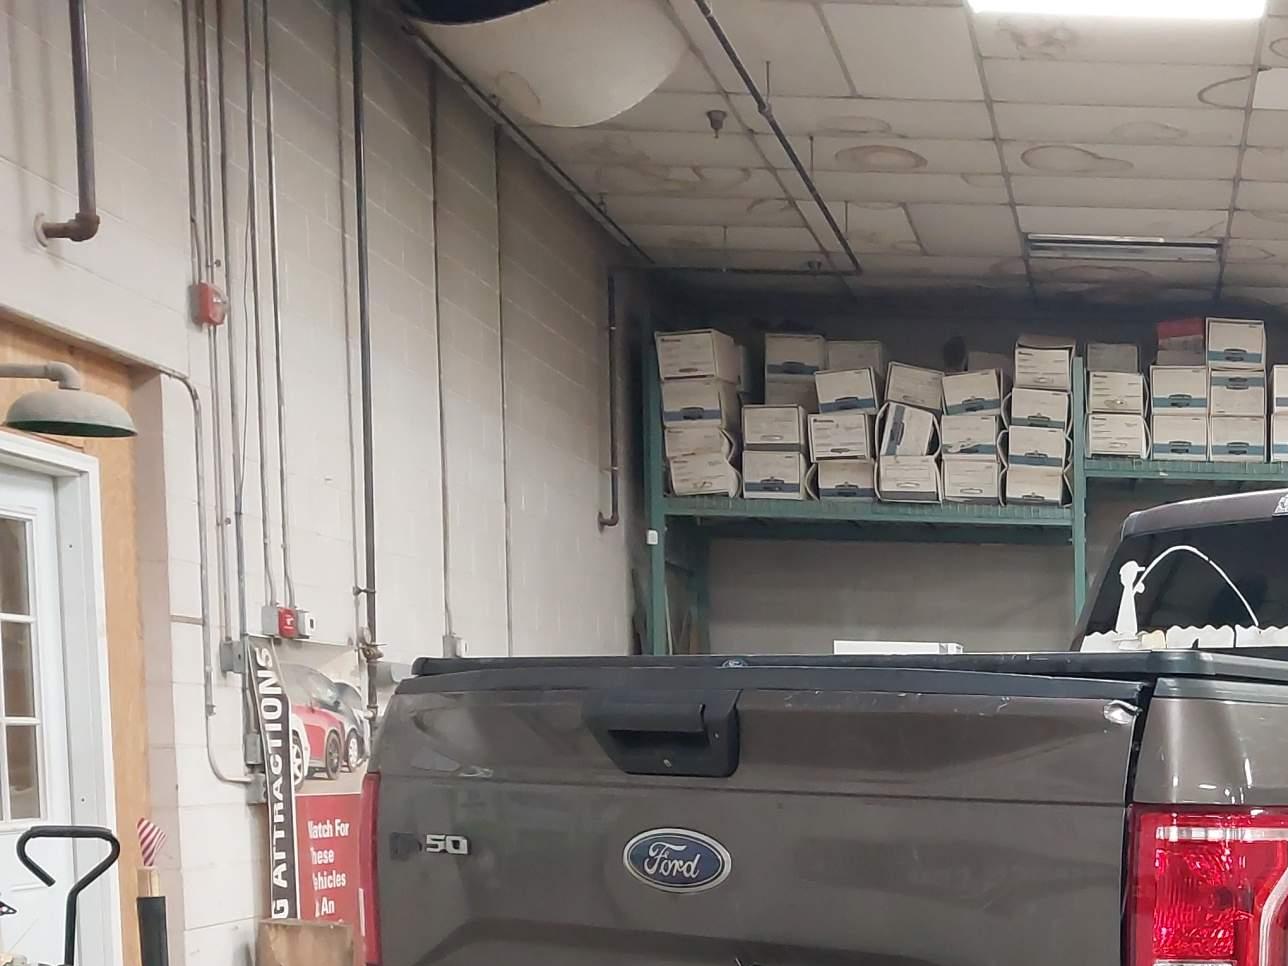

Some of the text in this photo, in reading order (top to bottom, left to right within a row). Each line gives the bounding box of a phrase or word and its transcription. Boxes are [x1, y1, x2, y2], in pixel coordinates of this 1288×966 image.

[255, 647, 289, 888] ATTRACTIONS
[335, 819, 349, 837] For
[644, 841, 701, 878] Ford
[313, 869, 346, 890] ehicles
[321, 896, 335, 916] An
